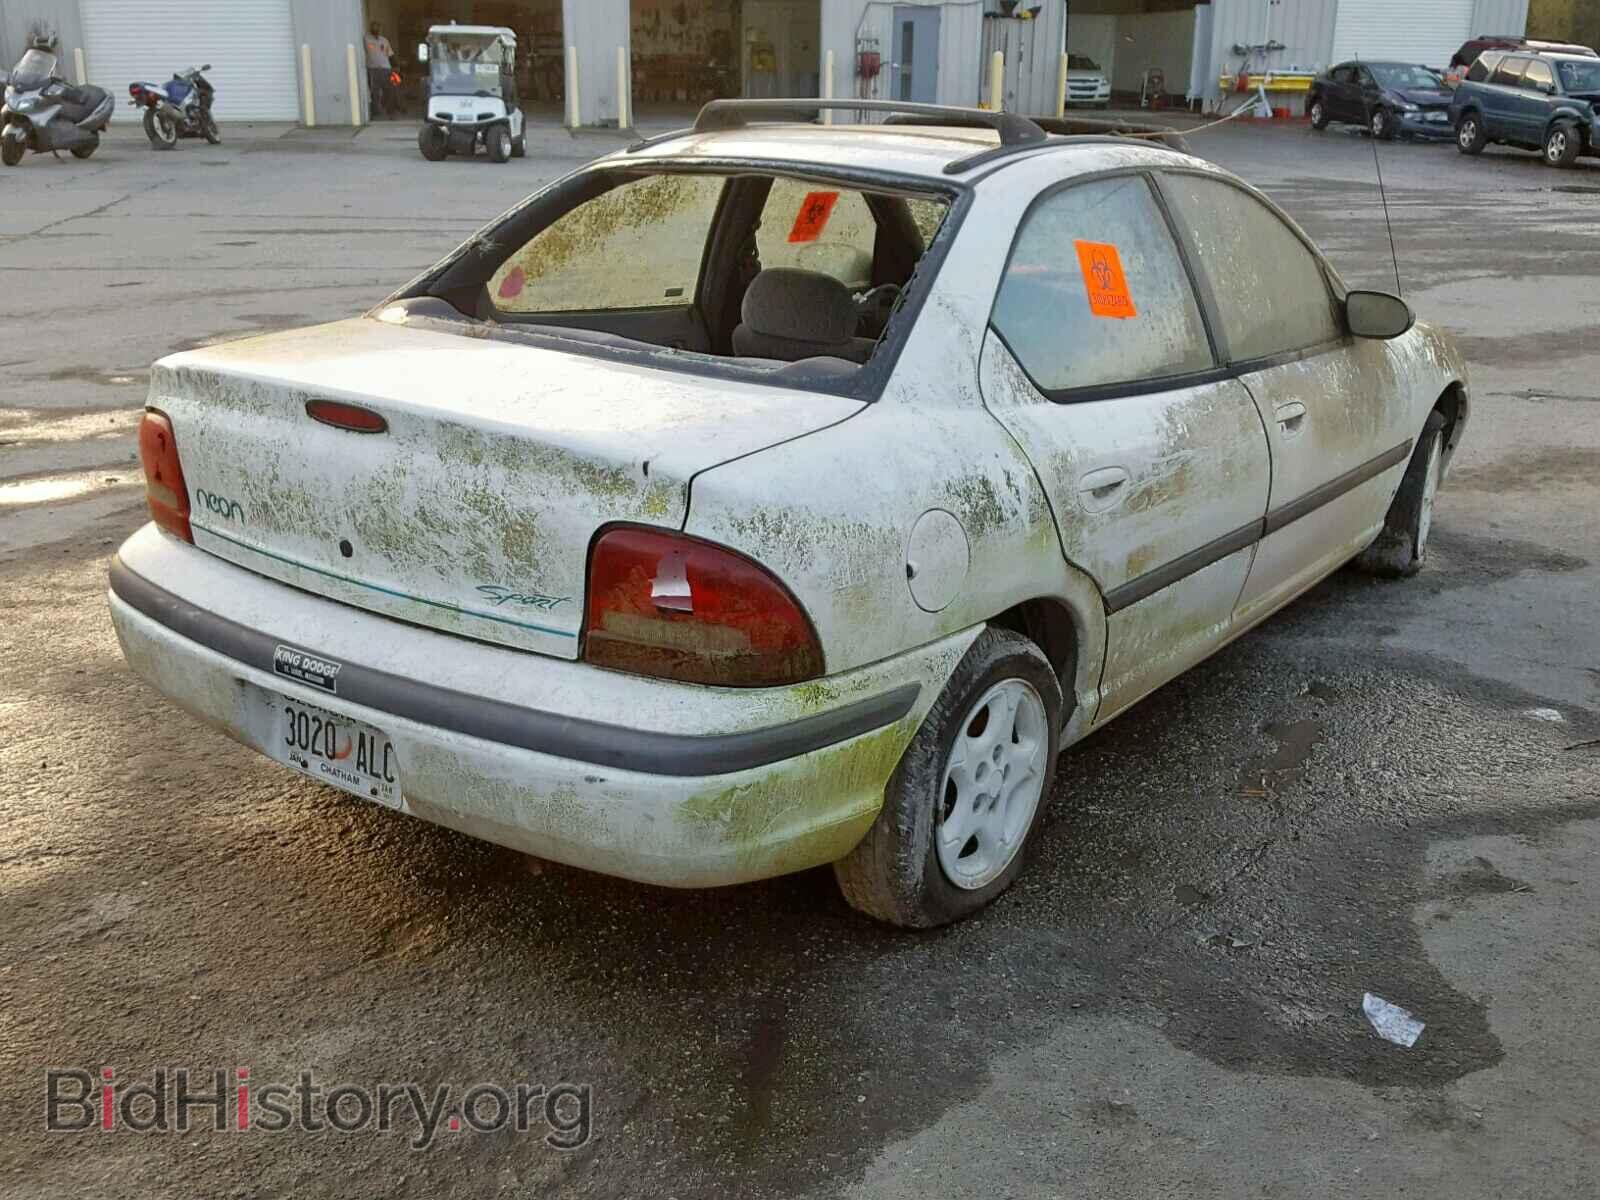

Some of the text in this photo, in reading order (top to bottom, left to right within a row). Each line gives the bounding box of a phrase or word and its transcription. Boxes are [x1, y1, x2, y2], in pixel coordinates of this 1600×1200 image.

[196, 488, 245, 524] neon
[275, 648, 301, 666] KING
[302, 657, 337, 679] DODGE
[284, 706, 336, 760] 3020
[356, 731, 395, 783] ALC
[320, 762, 361, 786] CHATHAM
